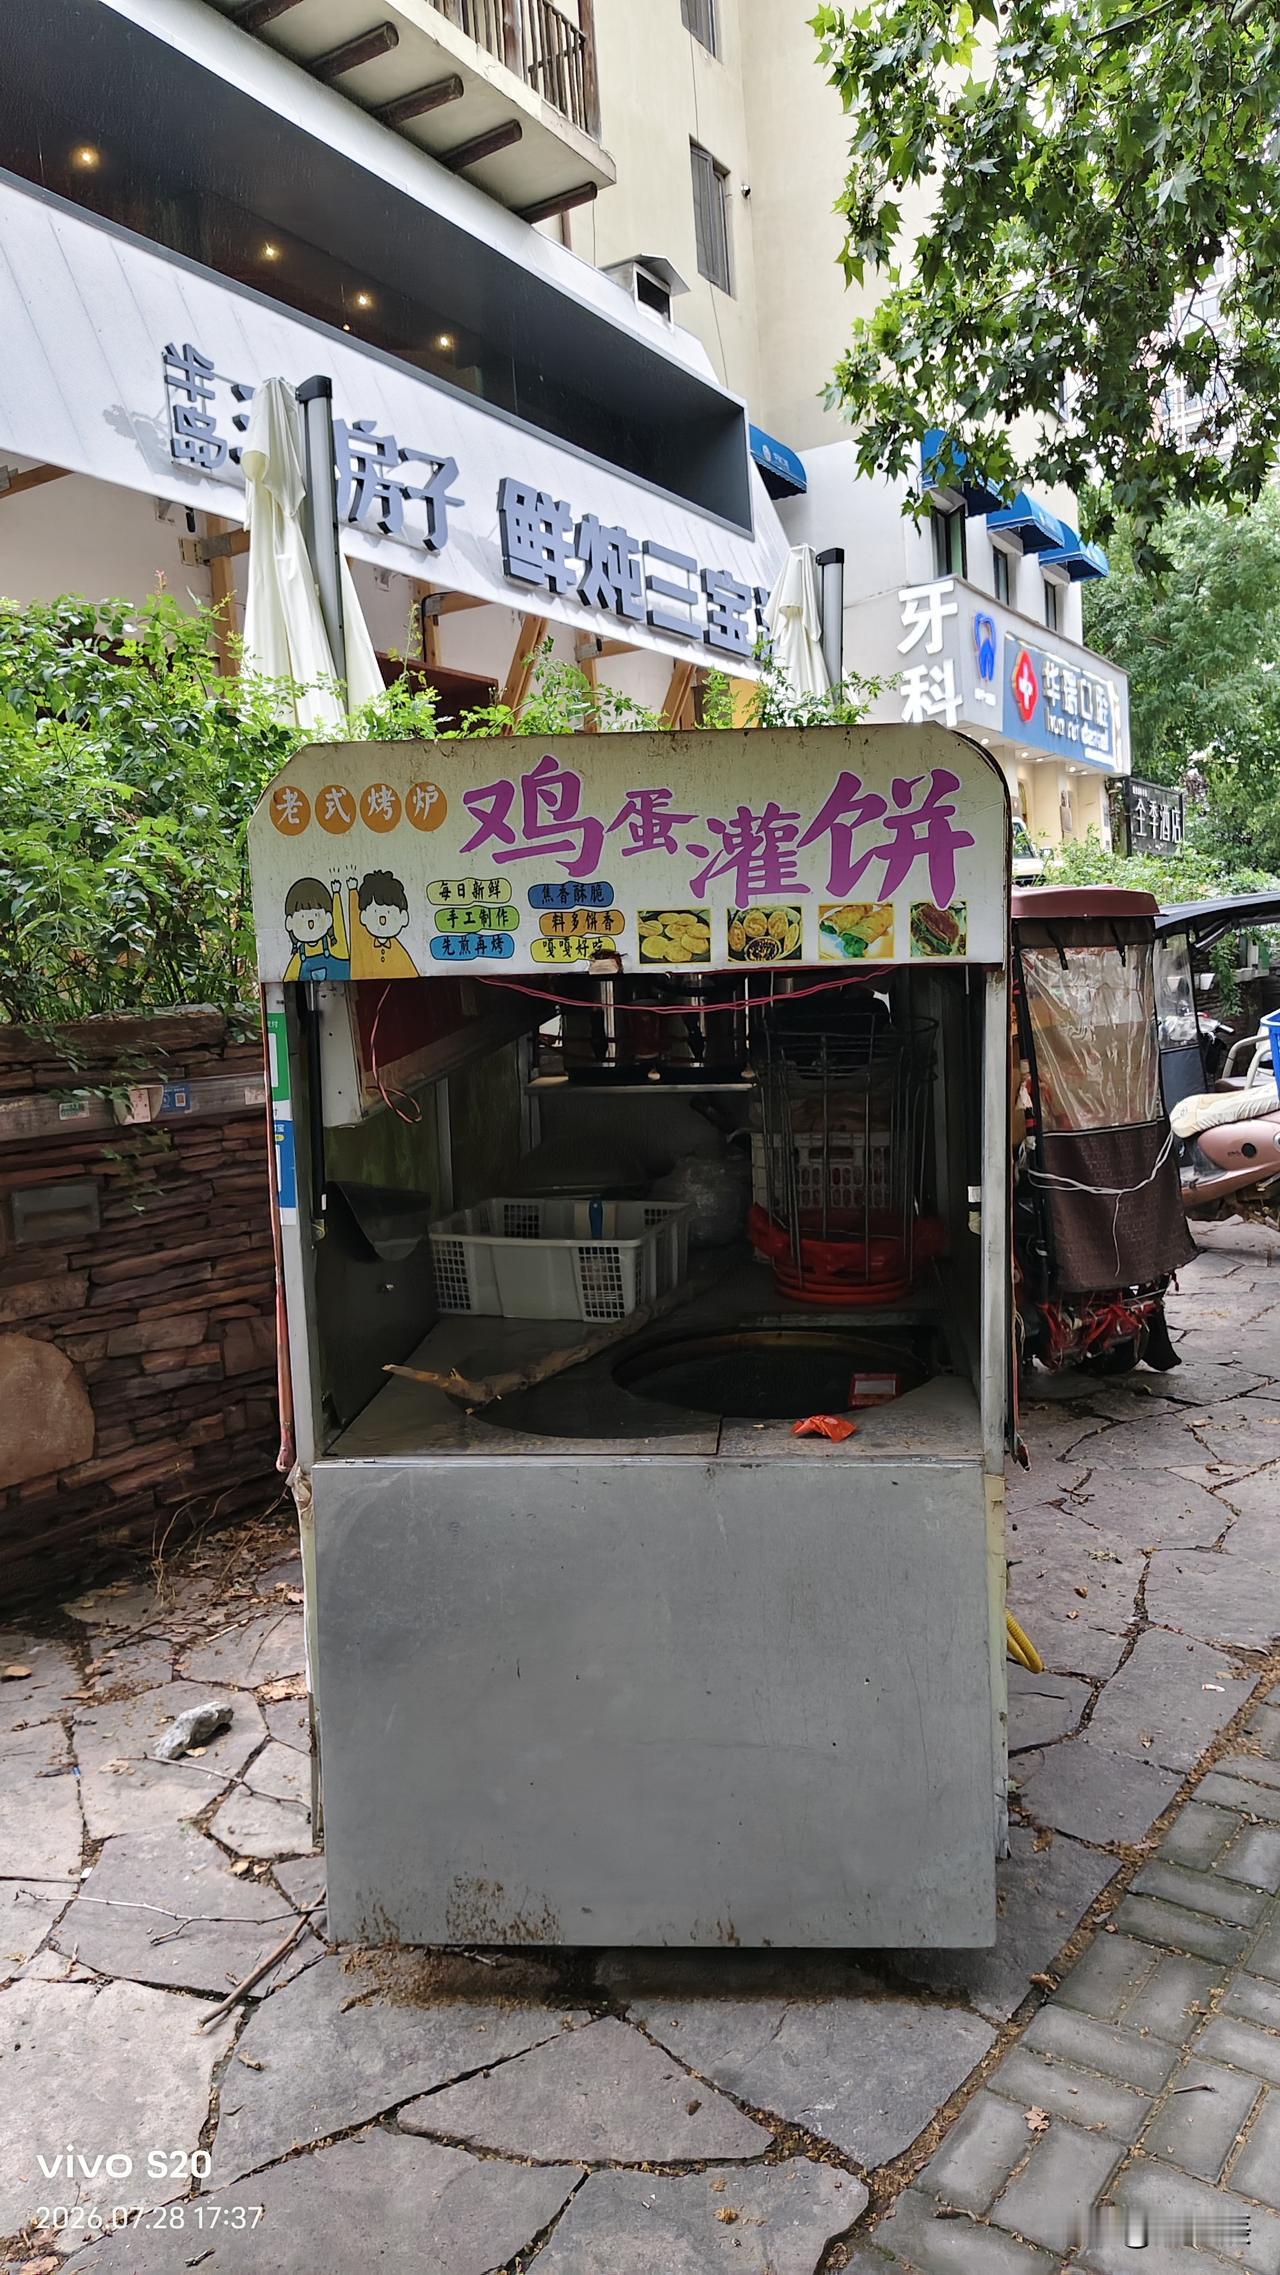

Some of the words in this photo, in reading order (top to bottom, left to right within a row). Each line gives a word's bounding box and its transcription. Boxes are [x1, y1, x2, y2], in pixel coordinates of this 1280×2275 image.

[896, 580, 963, 727] 牙科
[1043, 660, 1109, 729] 华瑞口腔
[276, 782, 440, 826] 老式烤炉
[1136, 798, 1181, 843] 全季酒店
[458, 754, 976, 912] 鸡蛋灌饼
[439, 880, 502, 901] 每日新鲜
[542, 883, 605, 904] 焦香酥脆
[446, 907, 509, 929] 手工制作
[551, 911, 615, 932] 料多饼香
[442, 935, 505, 956] 先煎再烤
